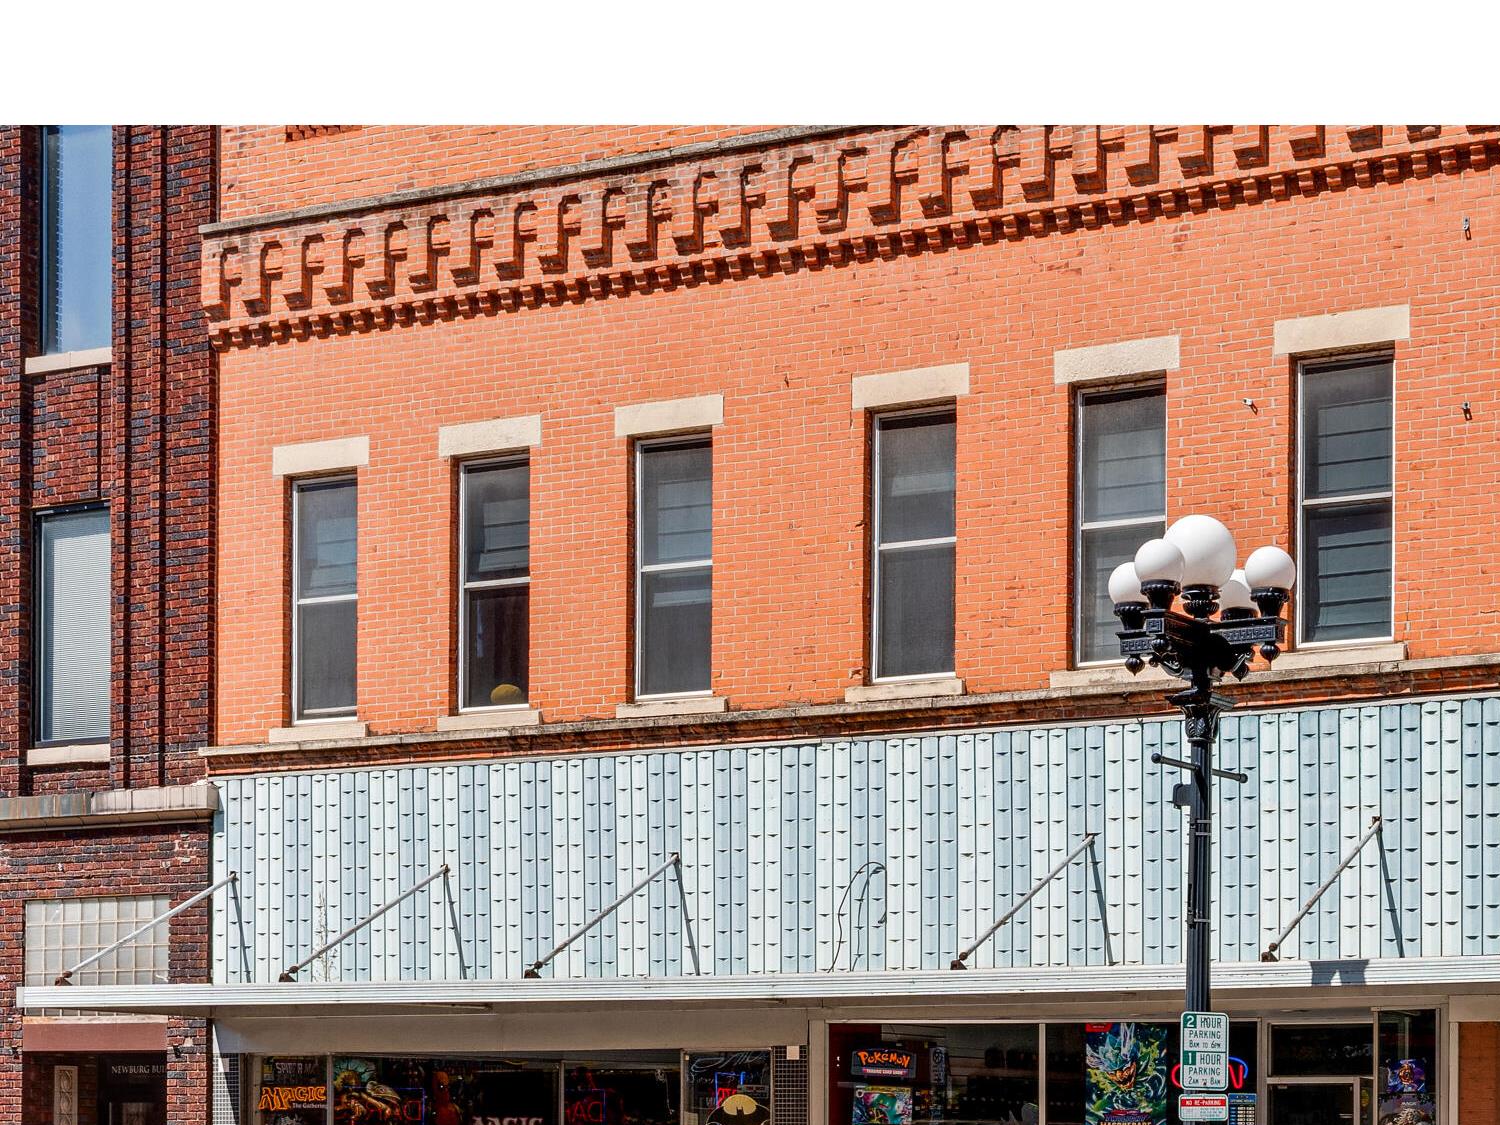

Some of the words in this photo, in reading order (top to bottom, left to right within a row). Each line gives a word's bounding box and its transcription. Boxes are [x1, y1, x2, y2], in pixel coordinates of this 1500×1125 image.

[1186, 1015, 1195, 1028] 2
[1200, 1017, 1222, 1029] HOUR
[1188, 1030, 1221, 1039] PARKING
[1189, 1040, 1200, 1048] 8AM
[1211, 1041, 1221, 1049] 6PM
[1188, 1052, 1192, 1064] 1
[1200, 1054, 1222, 1065] HOUR
[111, 1065, 150, 1074] NEWBURG
[1188, 1067, 1221, 1076] PARKING
[1188, 1077, 1199, 1085] 2AM
[1210, 1077, 1220, 1085] 8AM
[258, 1086, 327, 1111] MAGIC
